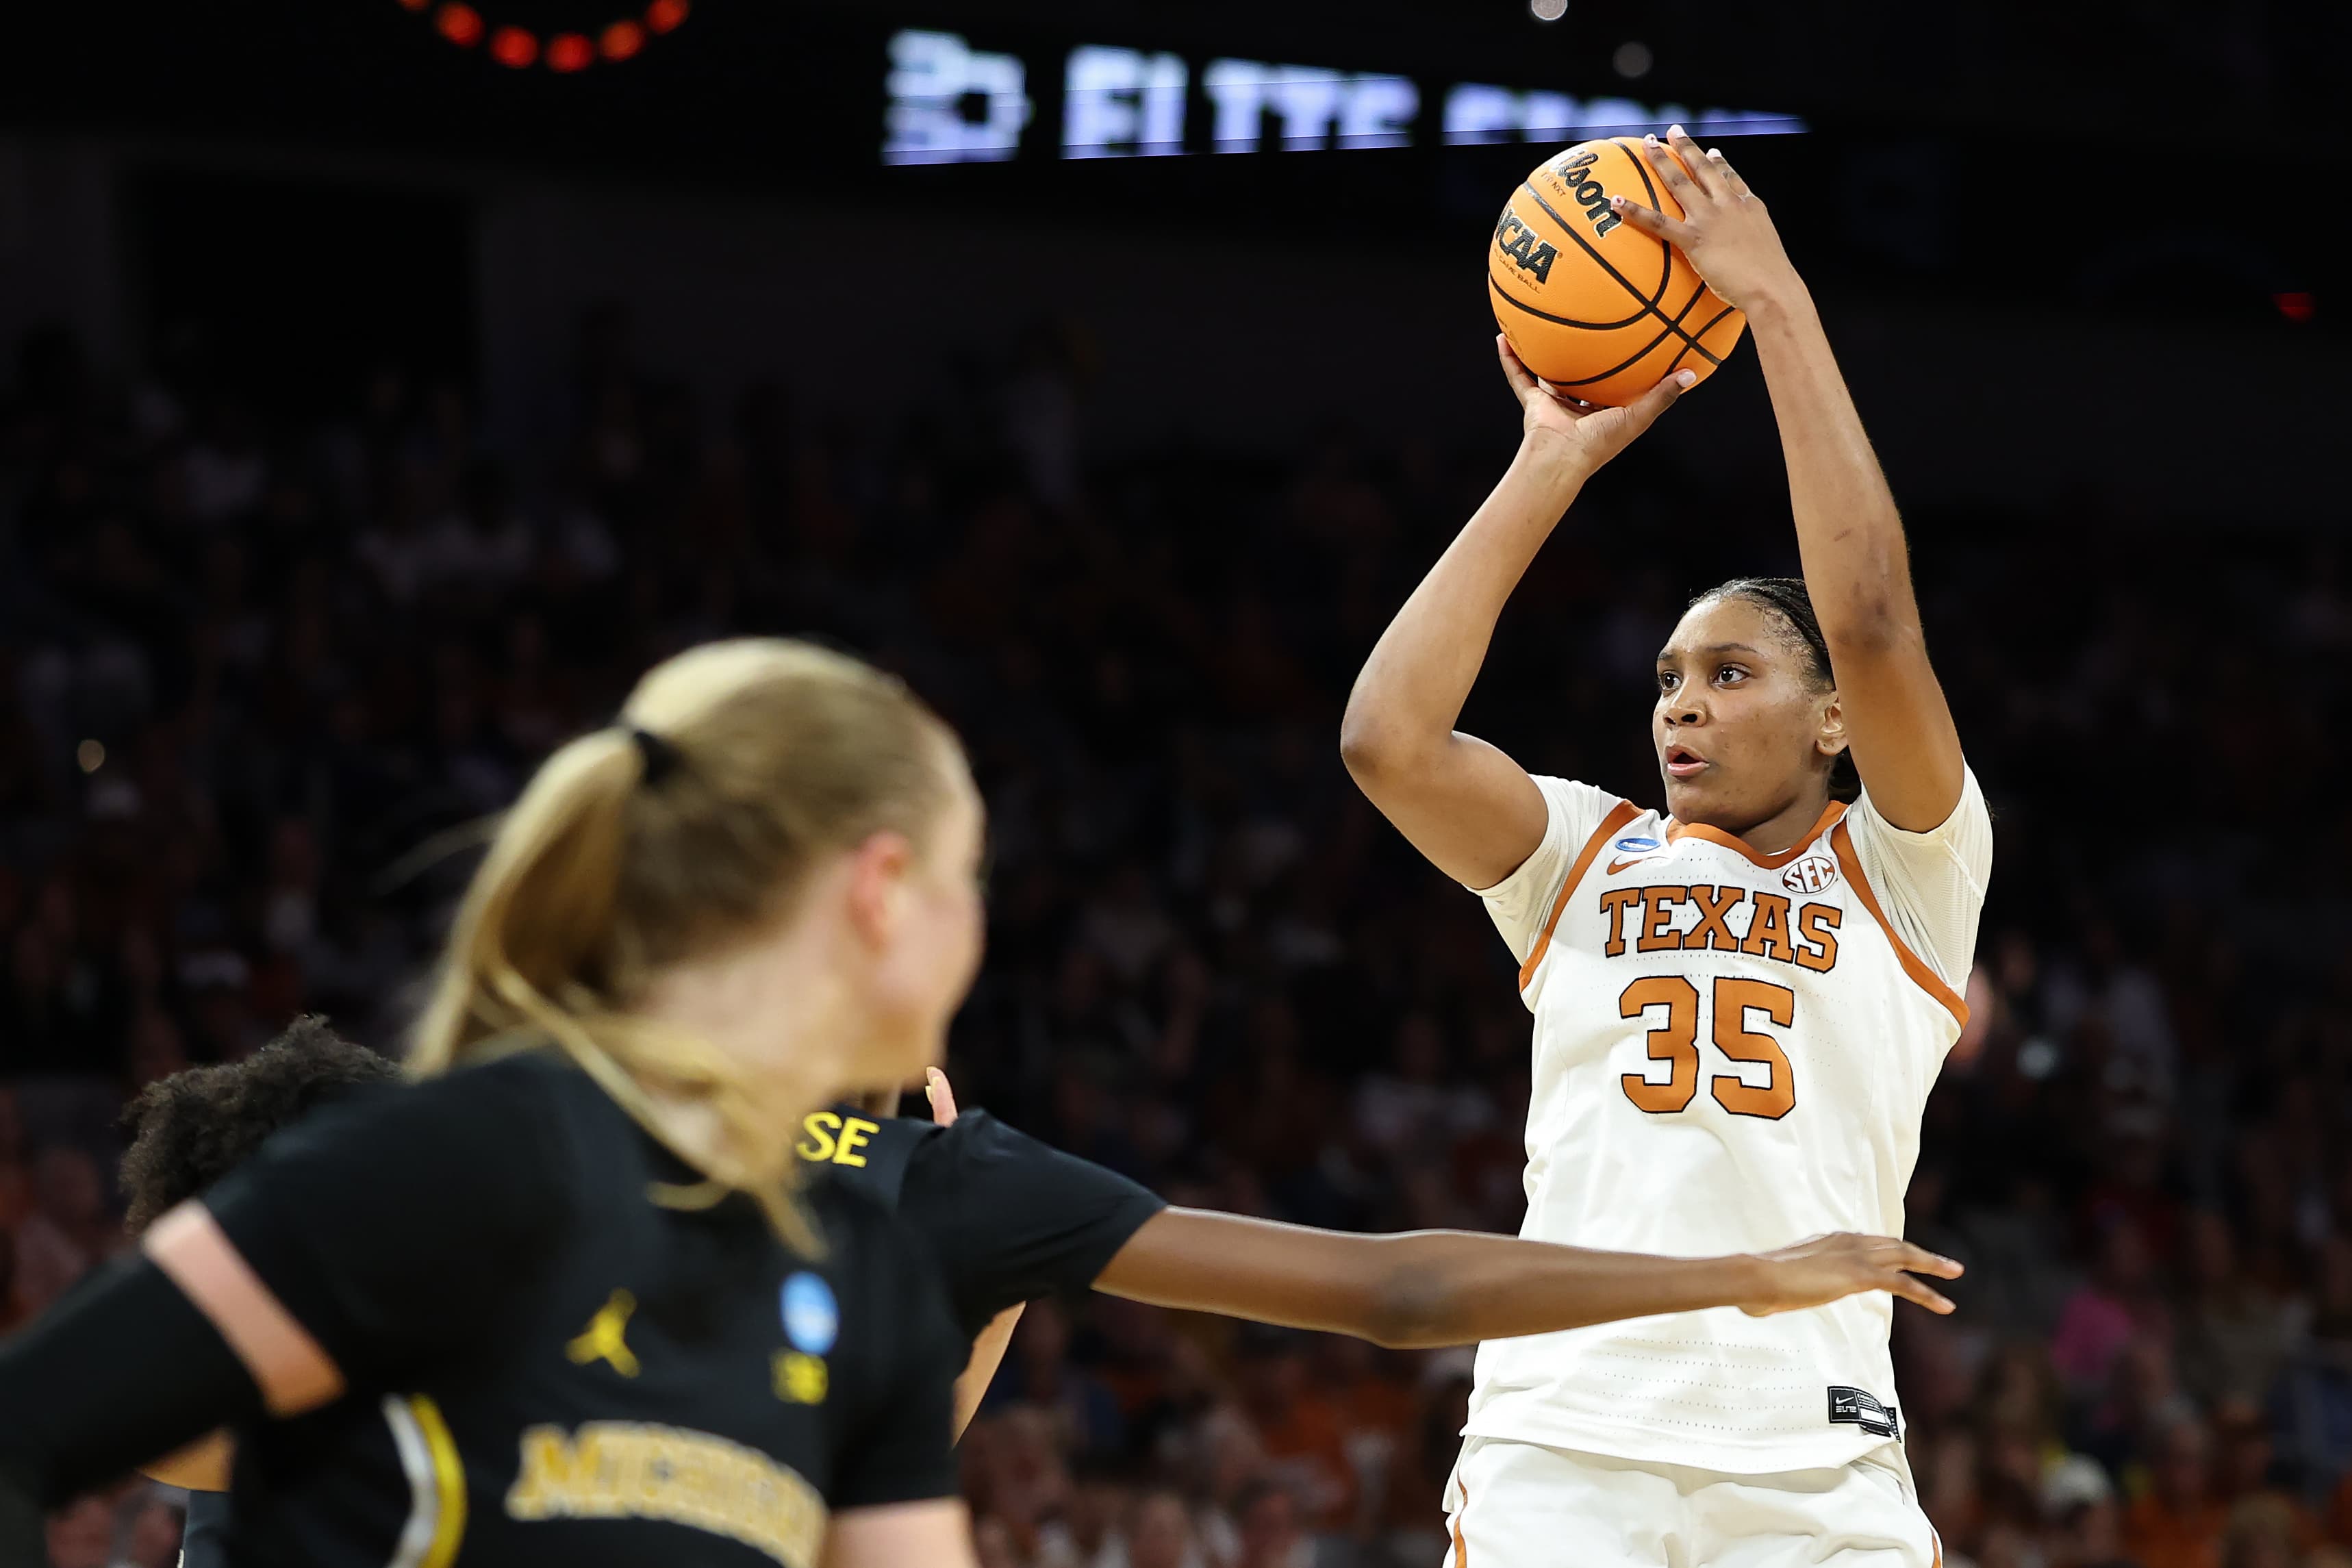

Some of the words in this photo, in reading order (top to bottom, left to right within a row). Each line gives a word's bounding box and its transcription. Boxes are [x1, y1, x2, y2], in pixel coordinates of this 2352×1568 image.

[1782, 855, 1837, 894] SEC
[1600, 884, 1843, 973] TEXAS
[1619, 975, 1796, 1120] 35
[796, 1111, 881, 1168] SE
